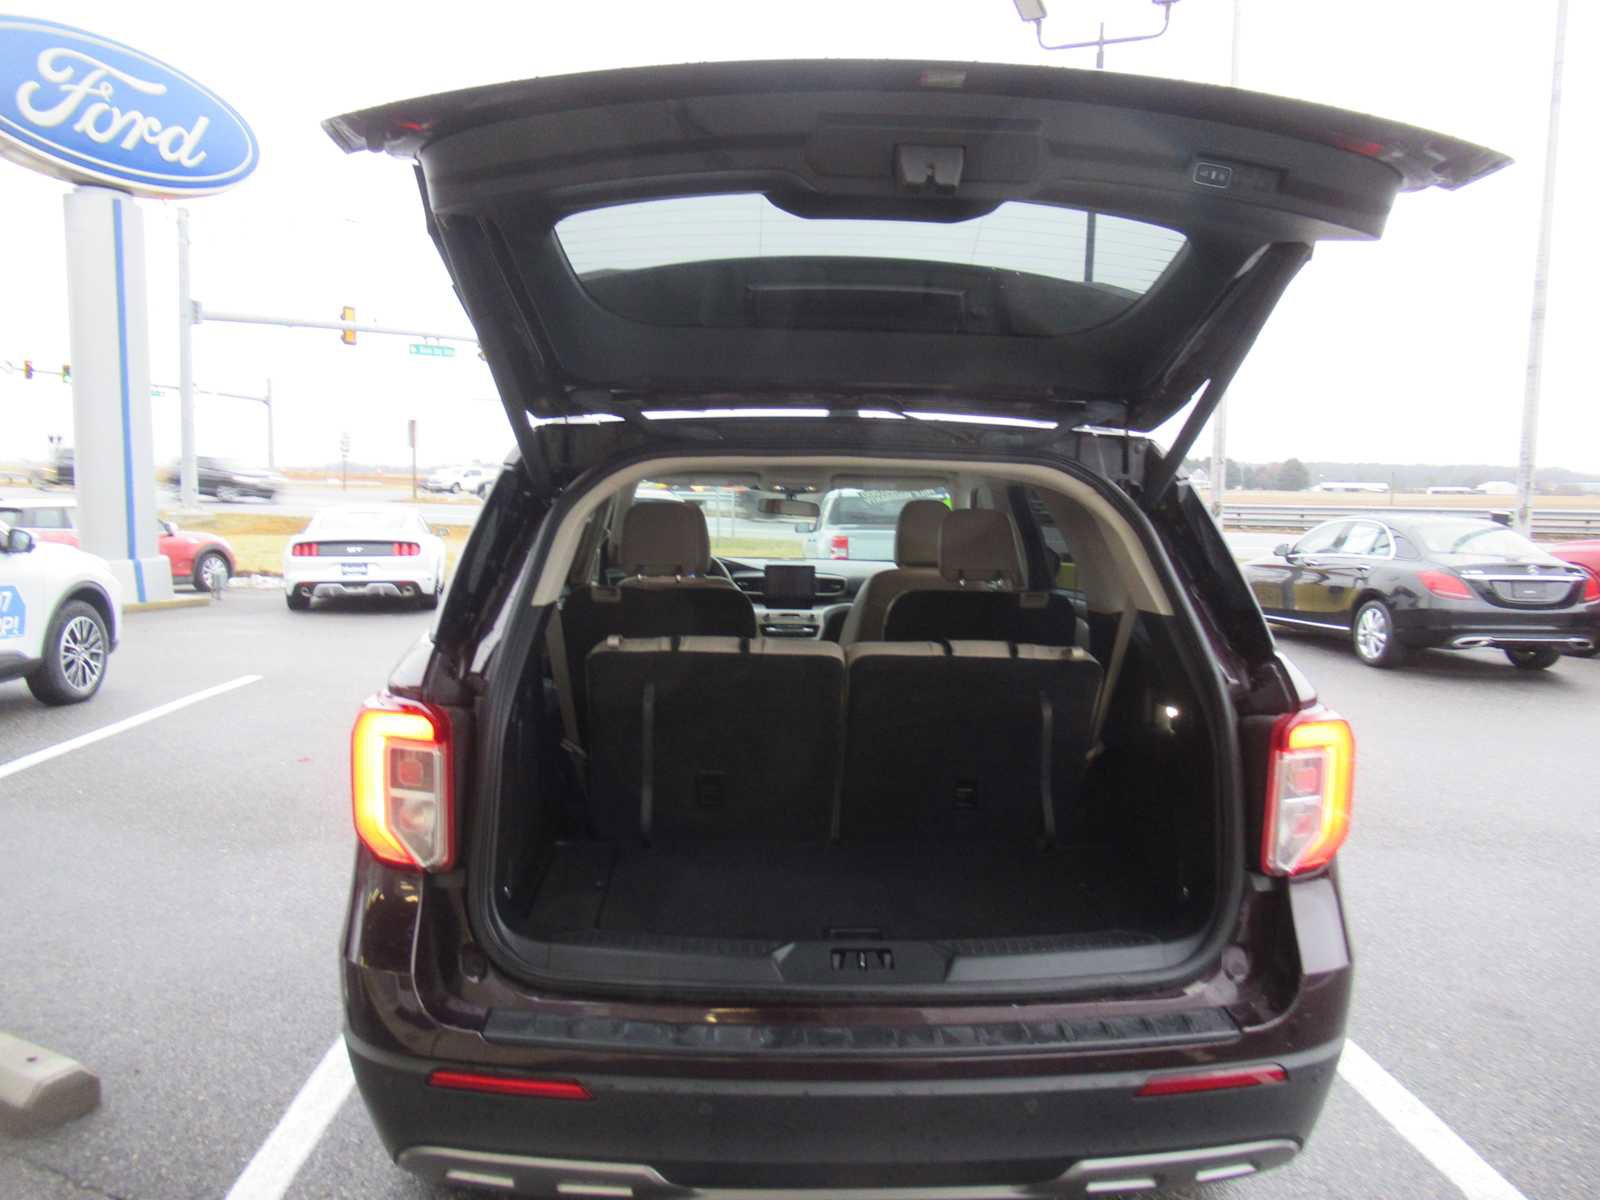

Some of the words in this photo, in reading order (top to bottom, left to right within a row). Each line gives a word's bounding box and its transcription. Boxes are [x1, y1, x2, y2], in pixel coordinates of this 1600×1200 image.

[16, 47, 210, 169] Ford
[0, 591, 12, 612] 7
[0, 616, 19, 636] P!
